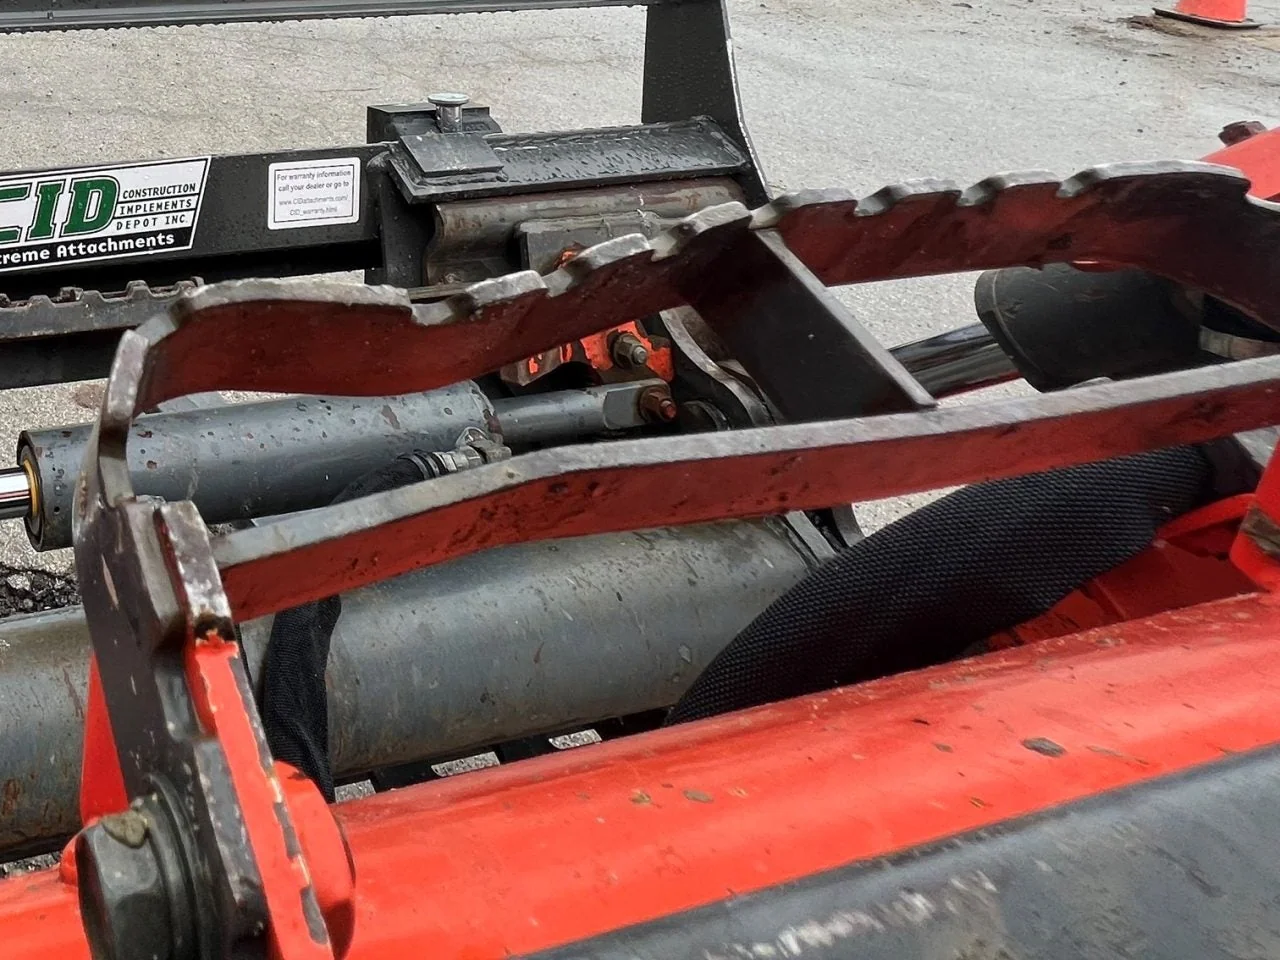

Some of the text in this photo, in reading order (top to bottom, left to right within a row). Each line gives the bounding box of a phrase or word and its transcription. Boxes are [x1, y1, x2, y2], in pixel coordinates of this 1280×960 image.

[289, 172, 315, 181] warranty
[317, 170, 351, 178] information
[122, 183, 196, 200] CONSTRUCTION
[290, 185, 304, 193] your
[120, 199, 193, 215] IMPLEMENTS
[116, 213, 189, 232] DEPOT INC.
[56, 232, 175, 259] Attachments
